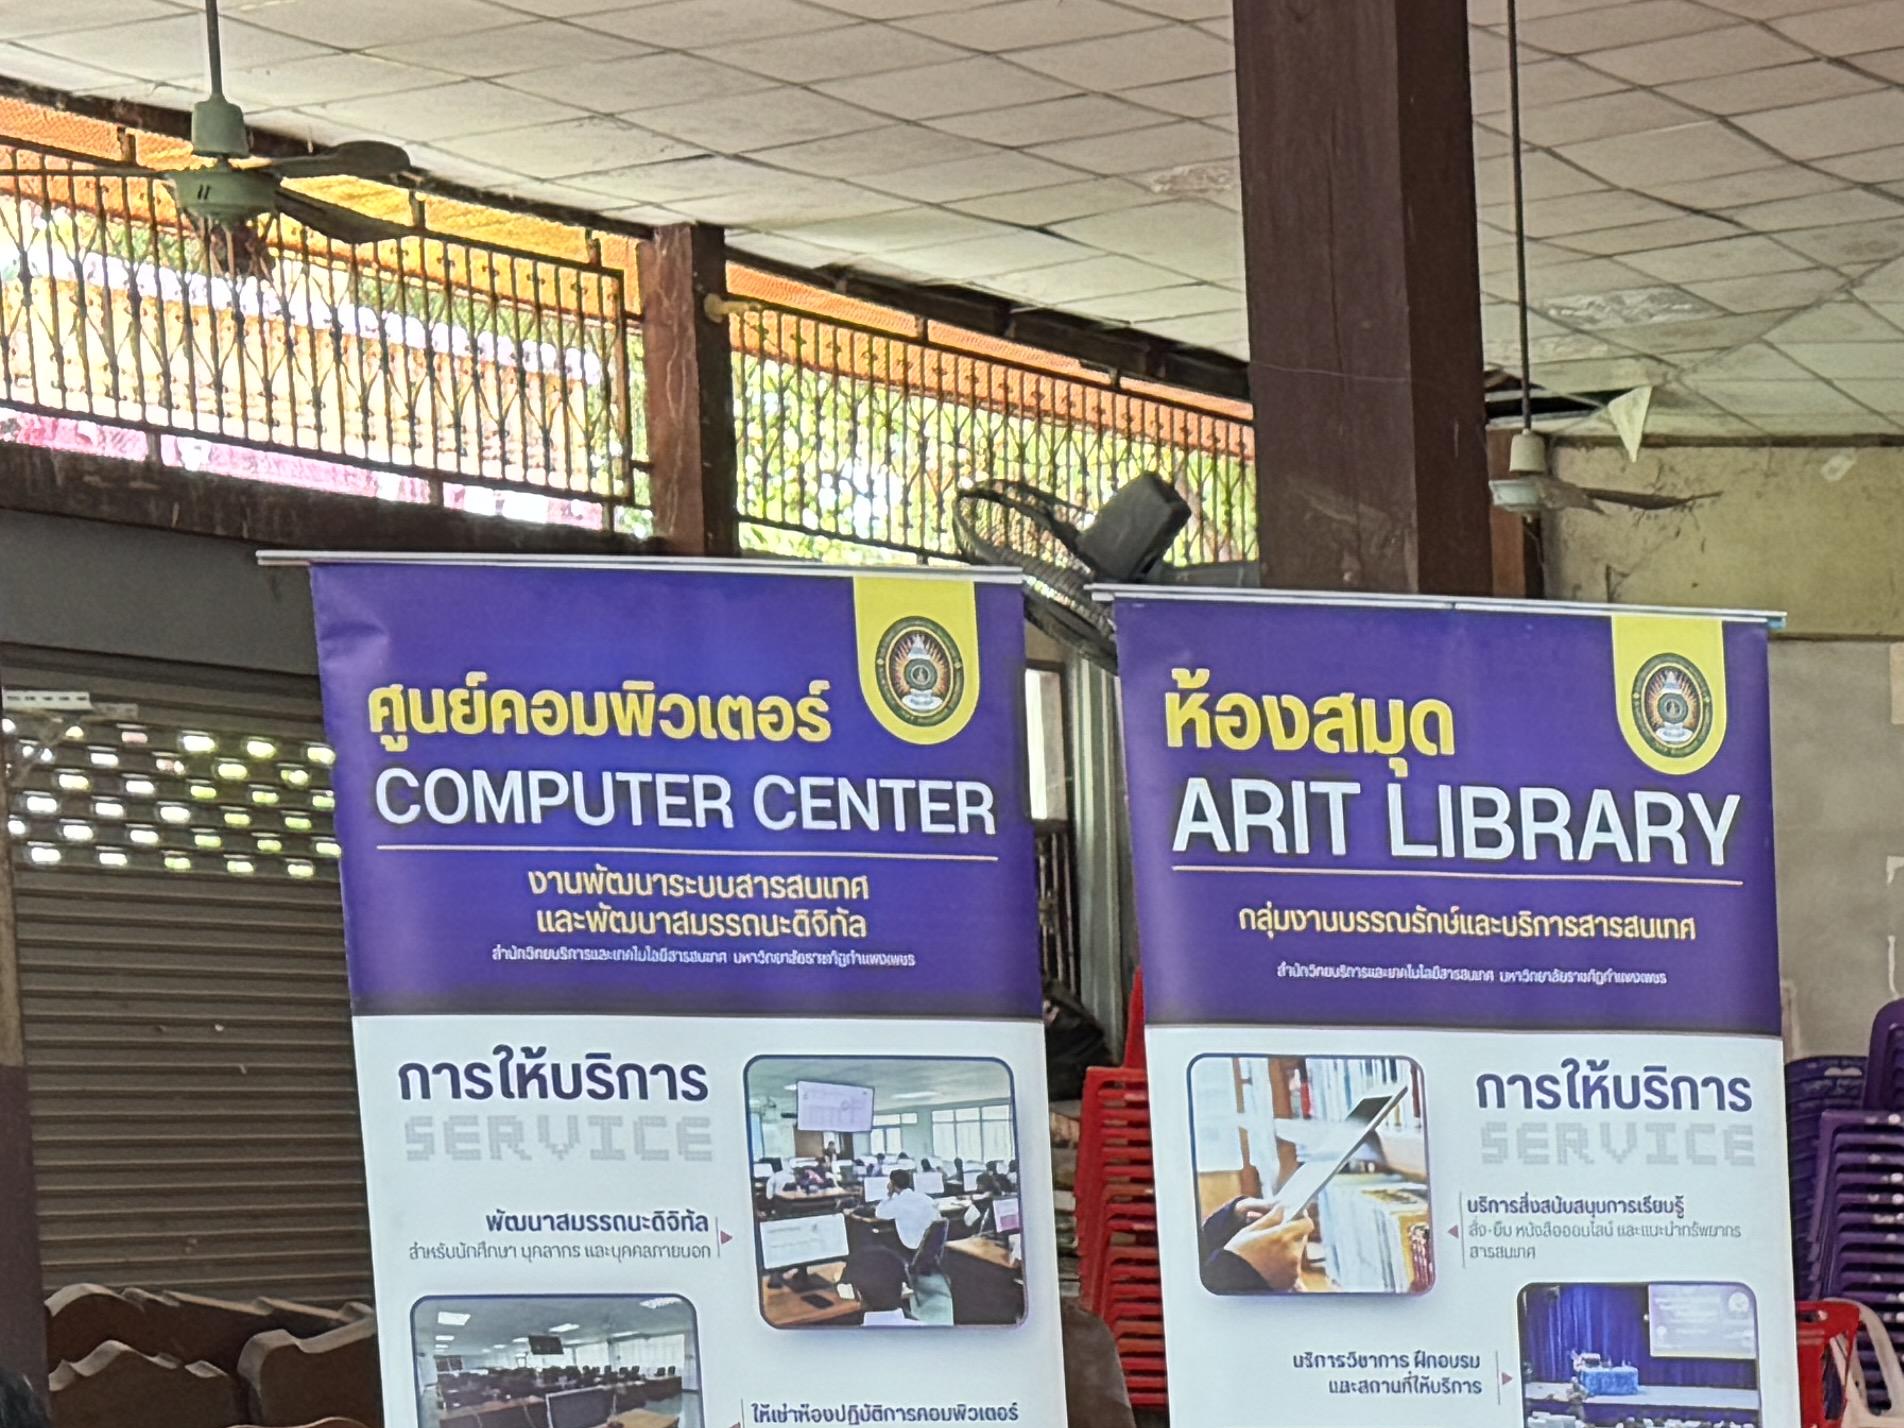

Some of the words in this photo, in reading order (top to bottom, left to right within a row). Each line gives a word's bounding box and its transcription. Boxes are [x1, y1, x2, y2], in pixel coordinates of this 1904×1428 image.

[368, 671, 832, 753] ศูนย์คอมพิวเตอร์
[1165, 668, 1456, 778] ห้องสมุด
[375, 767, 733, 829] COMPUTER
[753, 775, 996, 835] CENTER
[1172, 777, 1361, 855] ARIT
[1387, 783, 1741, 866] LIBRARY
[527, 864, 869, 901] งานพัฒนาระบบสารสนเทศ
[537, 904, 868, 938] และพัฒนาสมรรถนะดิจิทัล
[1238, 903, 1696, 942] กลุ่มงานบรรณรักษ์และบริการสารสนเทศ
[398, 1044, 708, 1101] การให้บริการ
[1476, 1057, 1753, 1113] การให้บริการ
[404, 1114, 713, 1162] SERVICE
[1481, 1121, 1756, 1167] SERVICE
